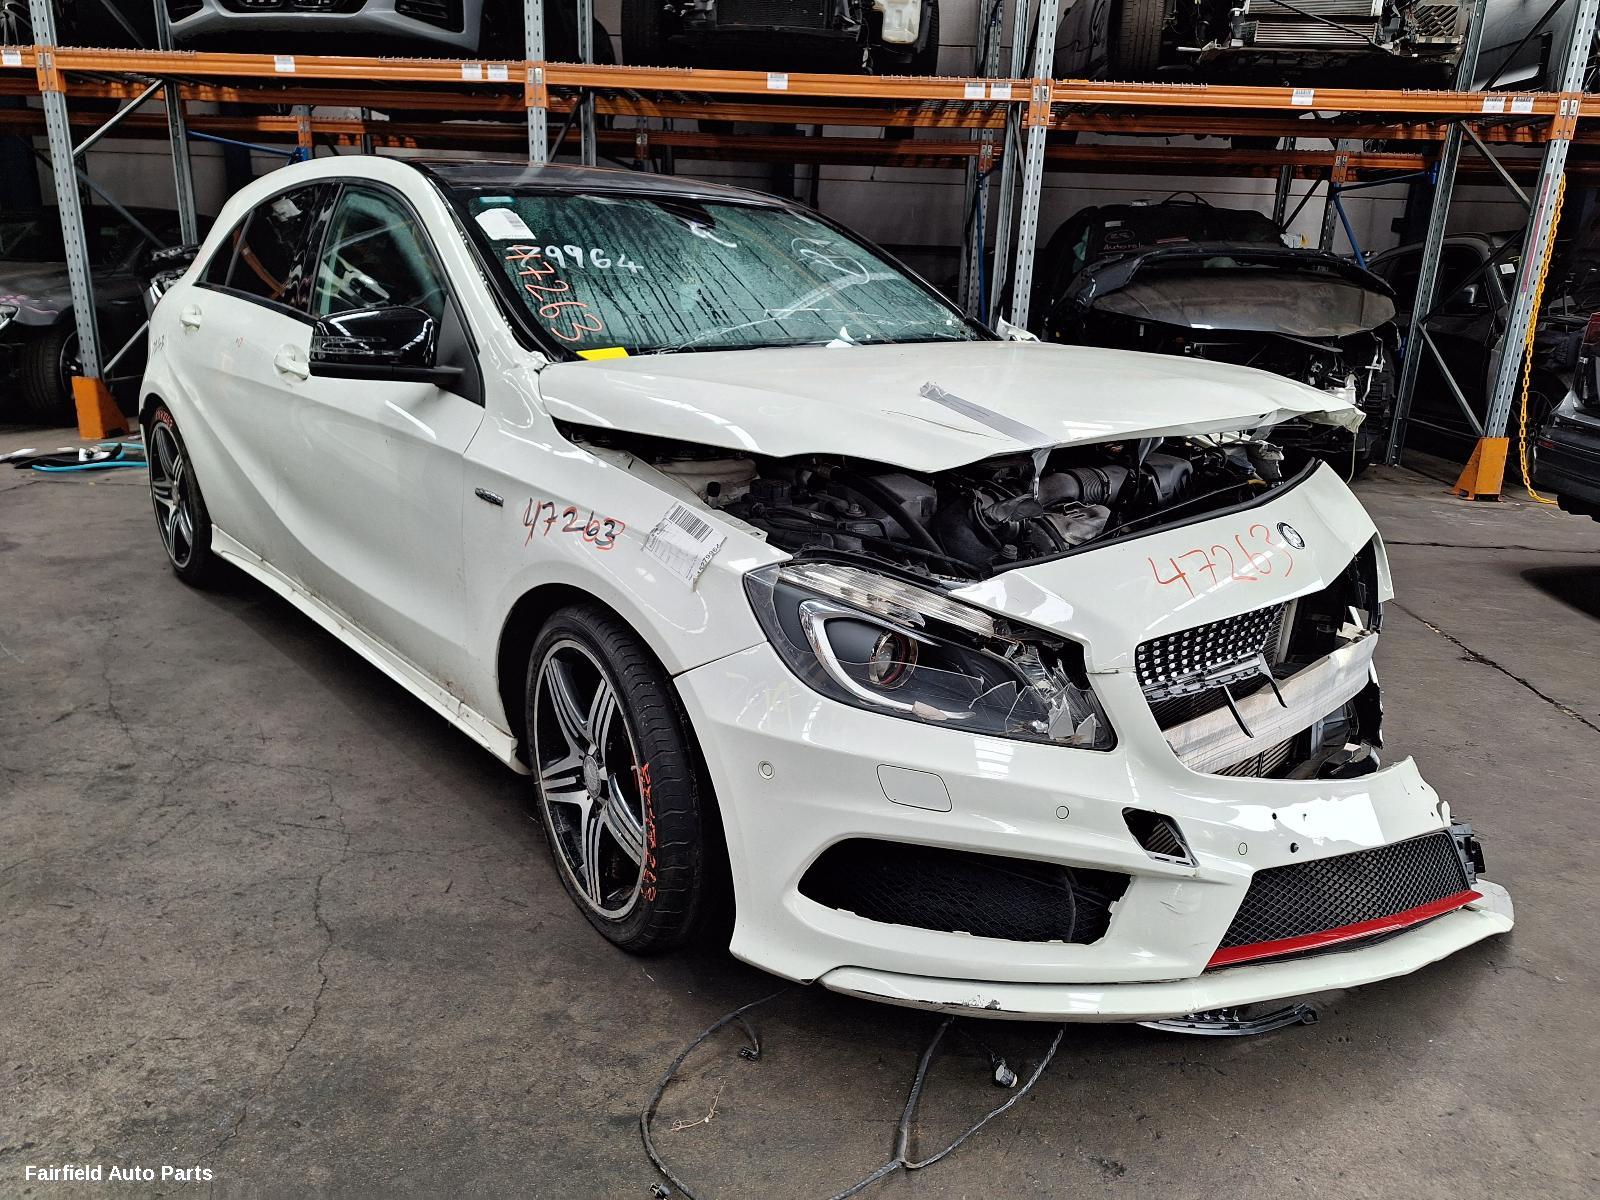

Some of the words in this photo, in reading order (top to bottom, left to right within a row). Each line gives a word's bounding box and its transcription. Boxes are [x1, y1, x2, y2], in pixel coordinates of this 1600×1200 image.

[505, 244, 603, 342] 47263
[523, 497, 626, 551] 47263
[1148, 524, 1294, 599] 47263
